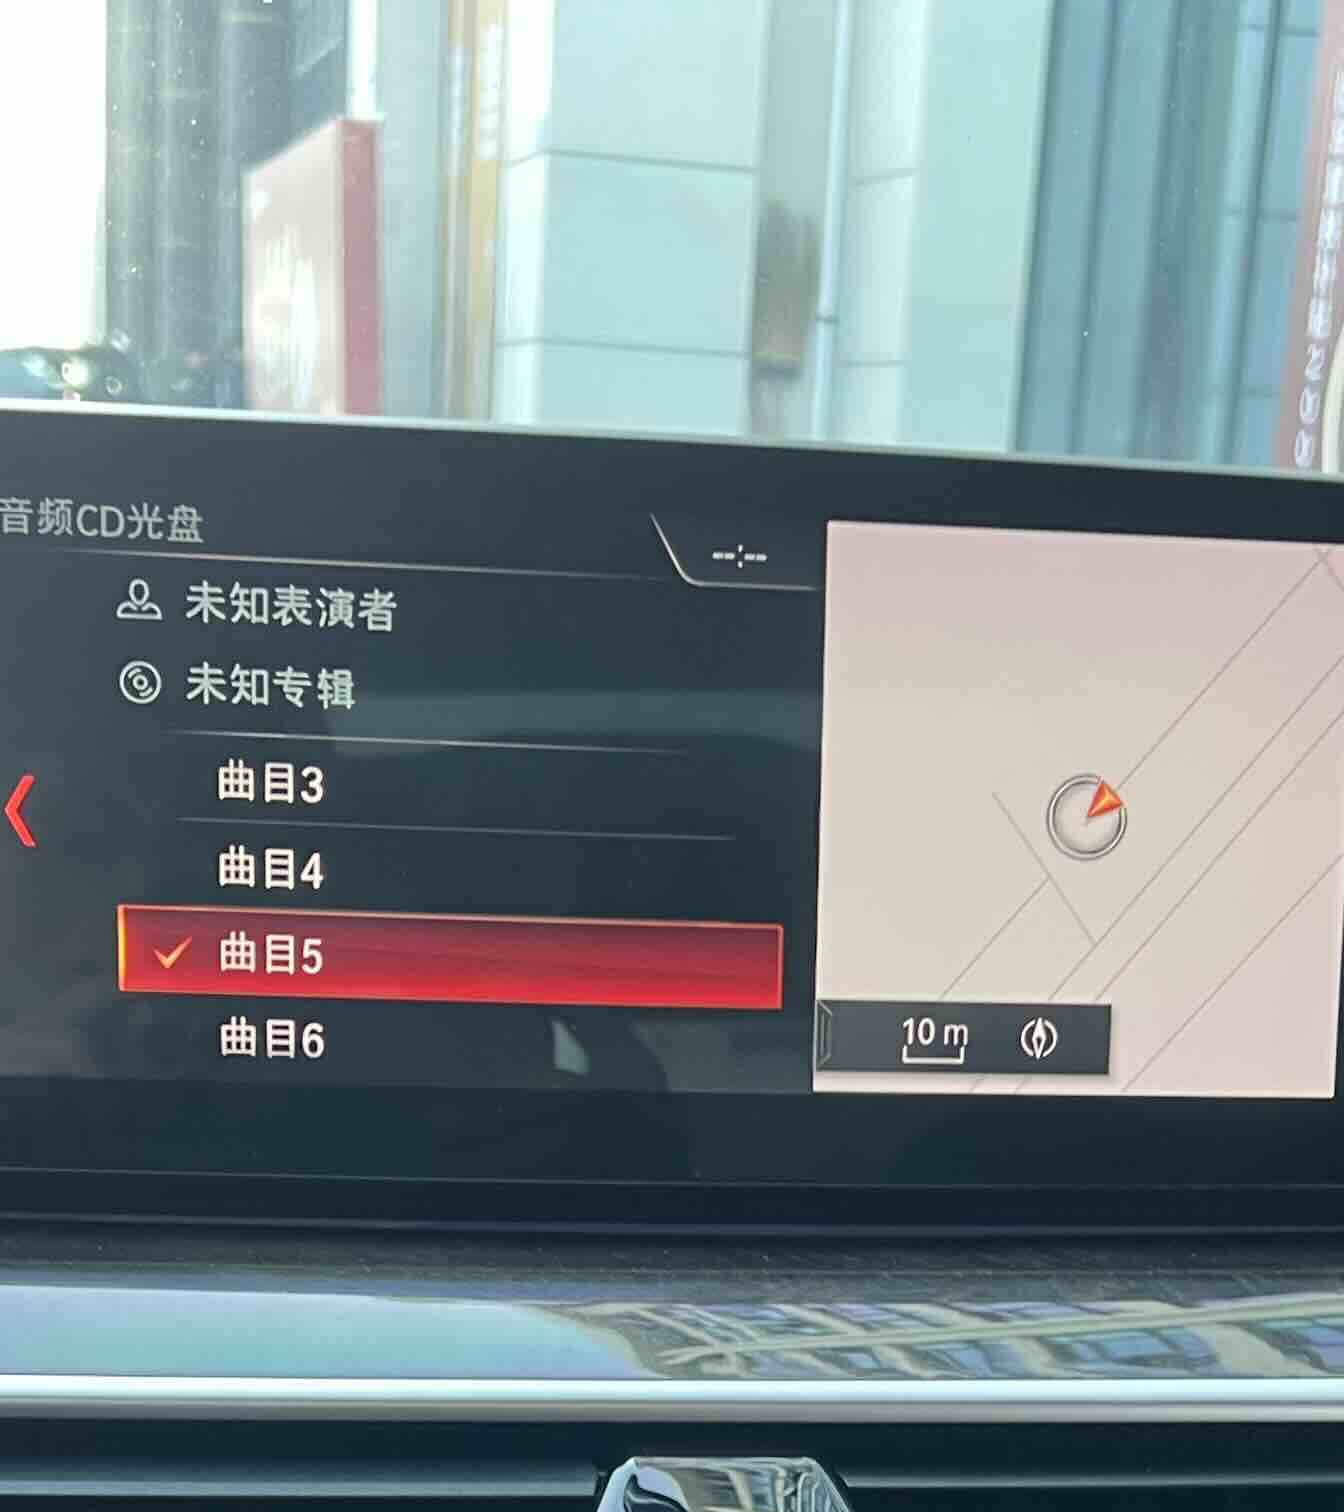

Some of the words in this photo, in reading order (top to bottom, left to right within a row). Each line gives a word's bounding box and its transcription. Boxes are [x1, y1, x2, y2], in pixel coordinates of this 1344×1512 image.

[185, 579, 398, 632] 未知表演者
[186, 660, 356, 710] 未知专辑
[218, 757, 325, 804] 曲目3
[218, 844, 325, 890] 曲目4
[219, 930, 324, 975] 曲目5
[219, 1015, 325, 1059] 曲目6
[902, 1017, 936, 1046] 10
[943, 1023, 969, 1046] m
